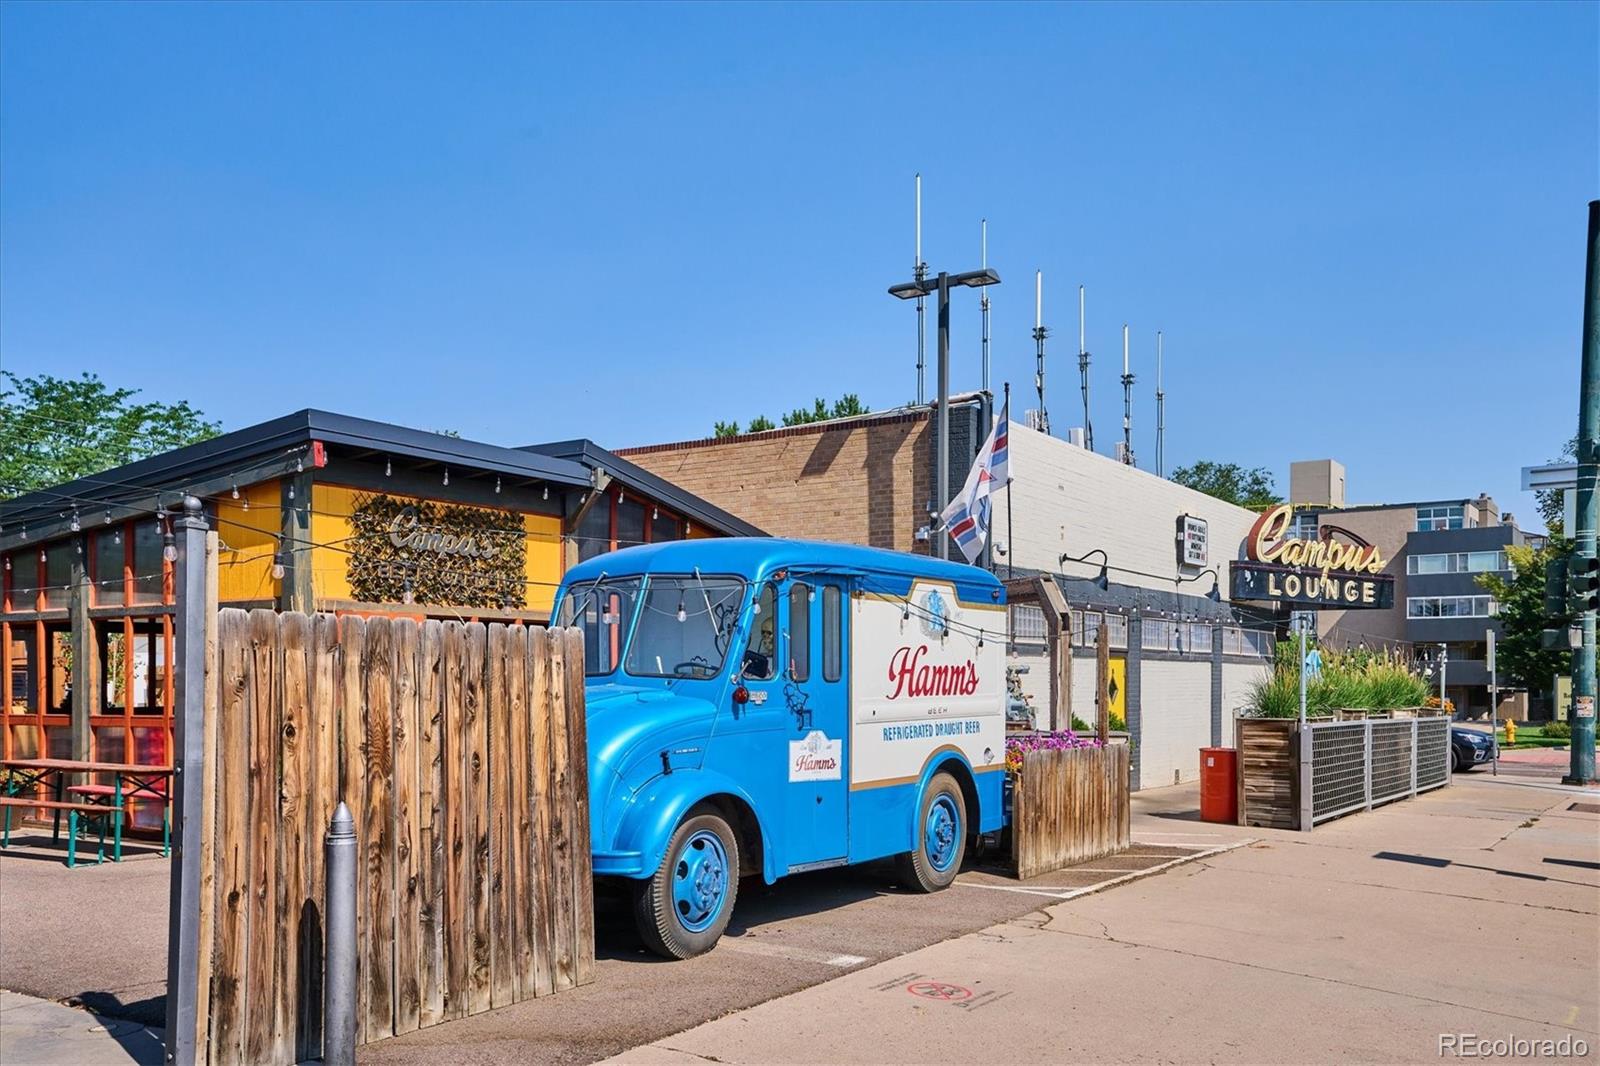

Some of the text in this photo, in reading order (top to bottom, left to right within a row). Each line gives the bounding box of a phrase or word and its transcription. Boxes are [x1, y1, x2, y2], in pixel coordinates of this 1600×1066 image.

[389, 506, 500, 560] Campus
[1256, 504, 1387, 588] Campus
[1268, 573, 1376, 603] LOUNGE
[886, 645, 980, 700] Hamm's
[883, 720, 981, 741] REFRIGERATED DRAUGHT BEER
[795, 754, 837, 772] Hamm's
